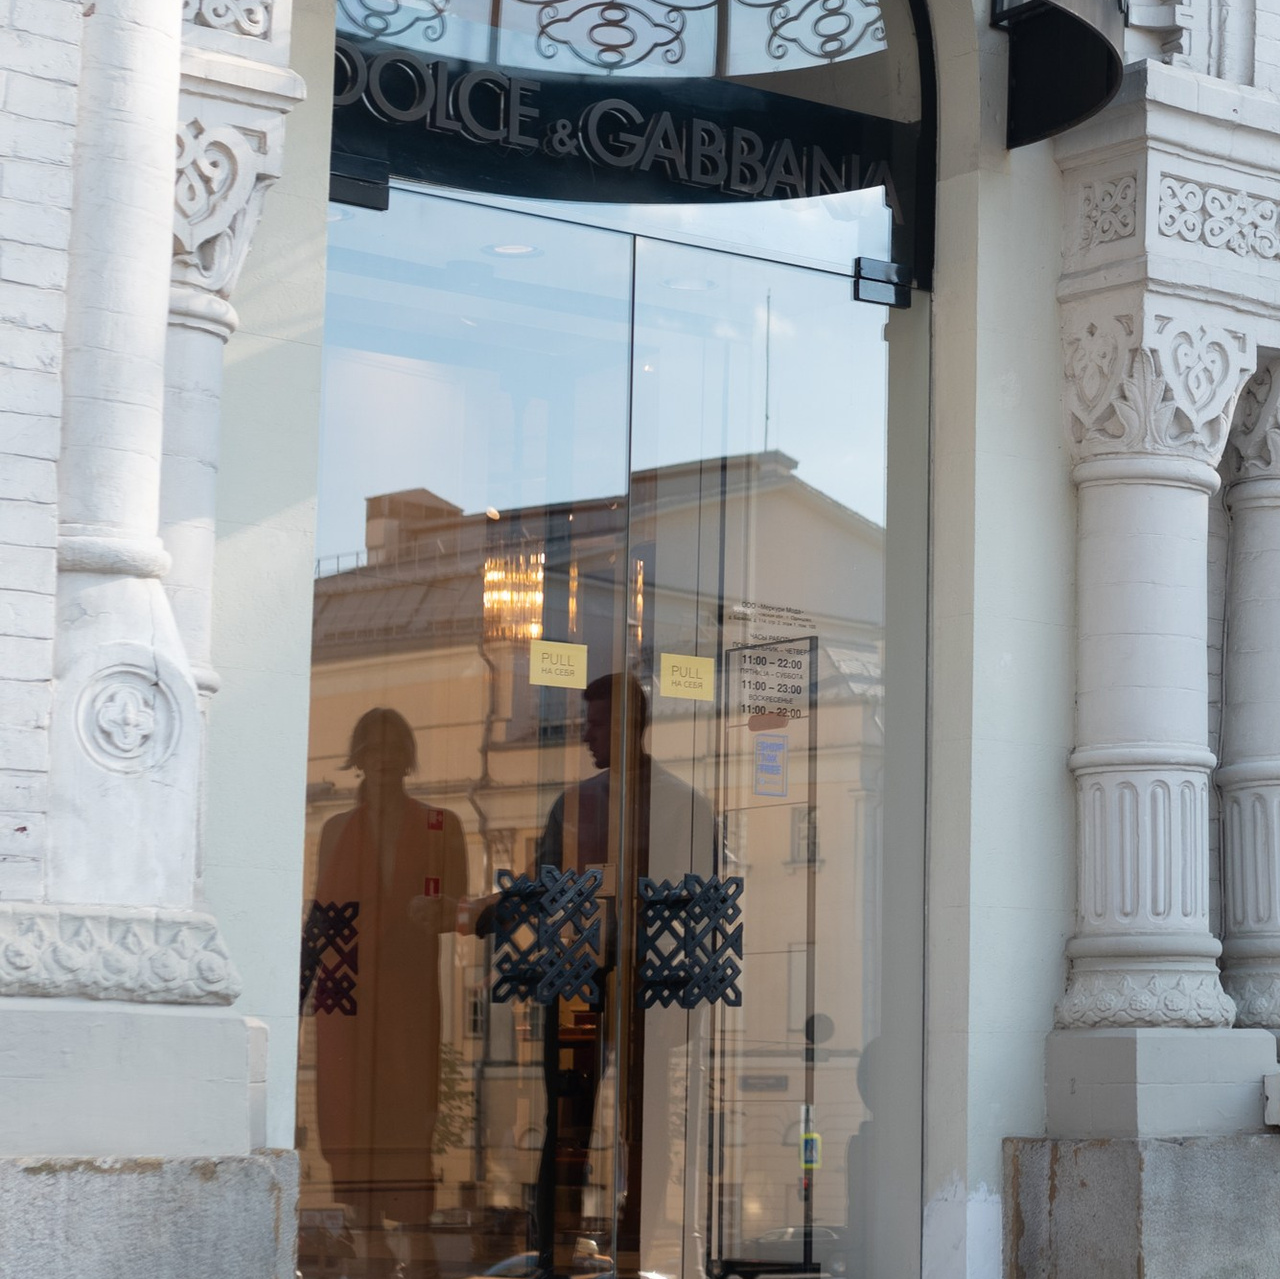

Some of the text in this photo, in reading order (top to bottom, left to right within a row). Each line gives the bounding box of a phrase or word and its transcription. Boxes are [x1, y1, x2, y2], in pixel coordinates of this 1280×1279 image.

[554, 118, 580, 156] &
[750, 633, 767, 641] ЧАСЫ
[541, 652, 575, 667] PULL
[742, 655, 767, 666] 11:00
[777, 658, 802, 670] 22:00
[541, 667, 575, 677] НА СЕБЯ
[671, 665, 703, 680] PULL
[775, 672, 803, 680] СУББОТА
[671, 679, 703, 690] НА СЕБЯ
[742, 680, 766, 691] 11:00
[777, 683, 802, 694] 23:00
[749, 694, 793, 704] ВОСКРЕСЕНЬЕ
[741, 704, 766, 715] 11:00
[776, 707, 801, 718] 22:00
